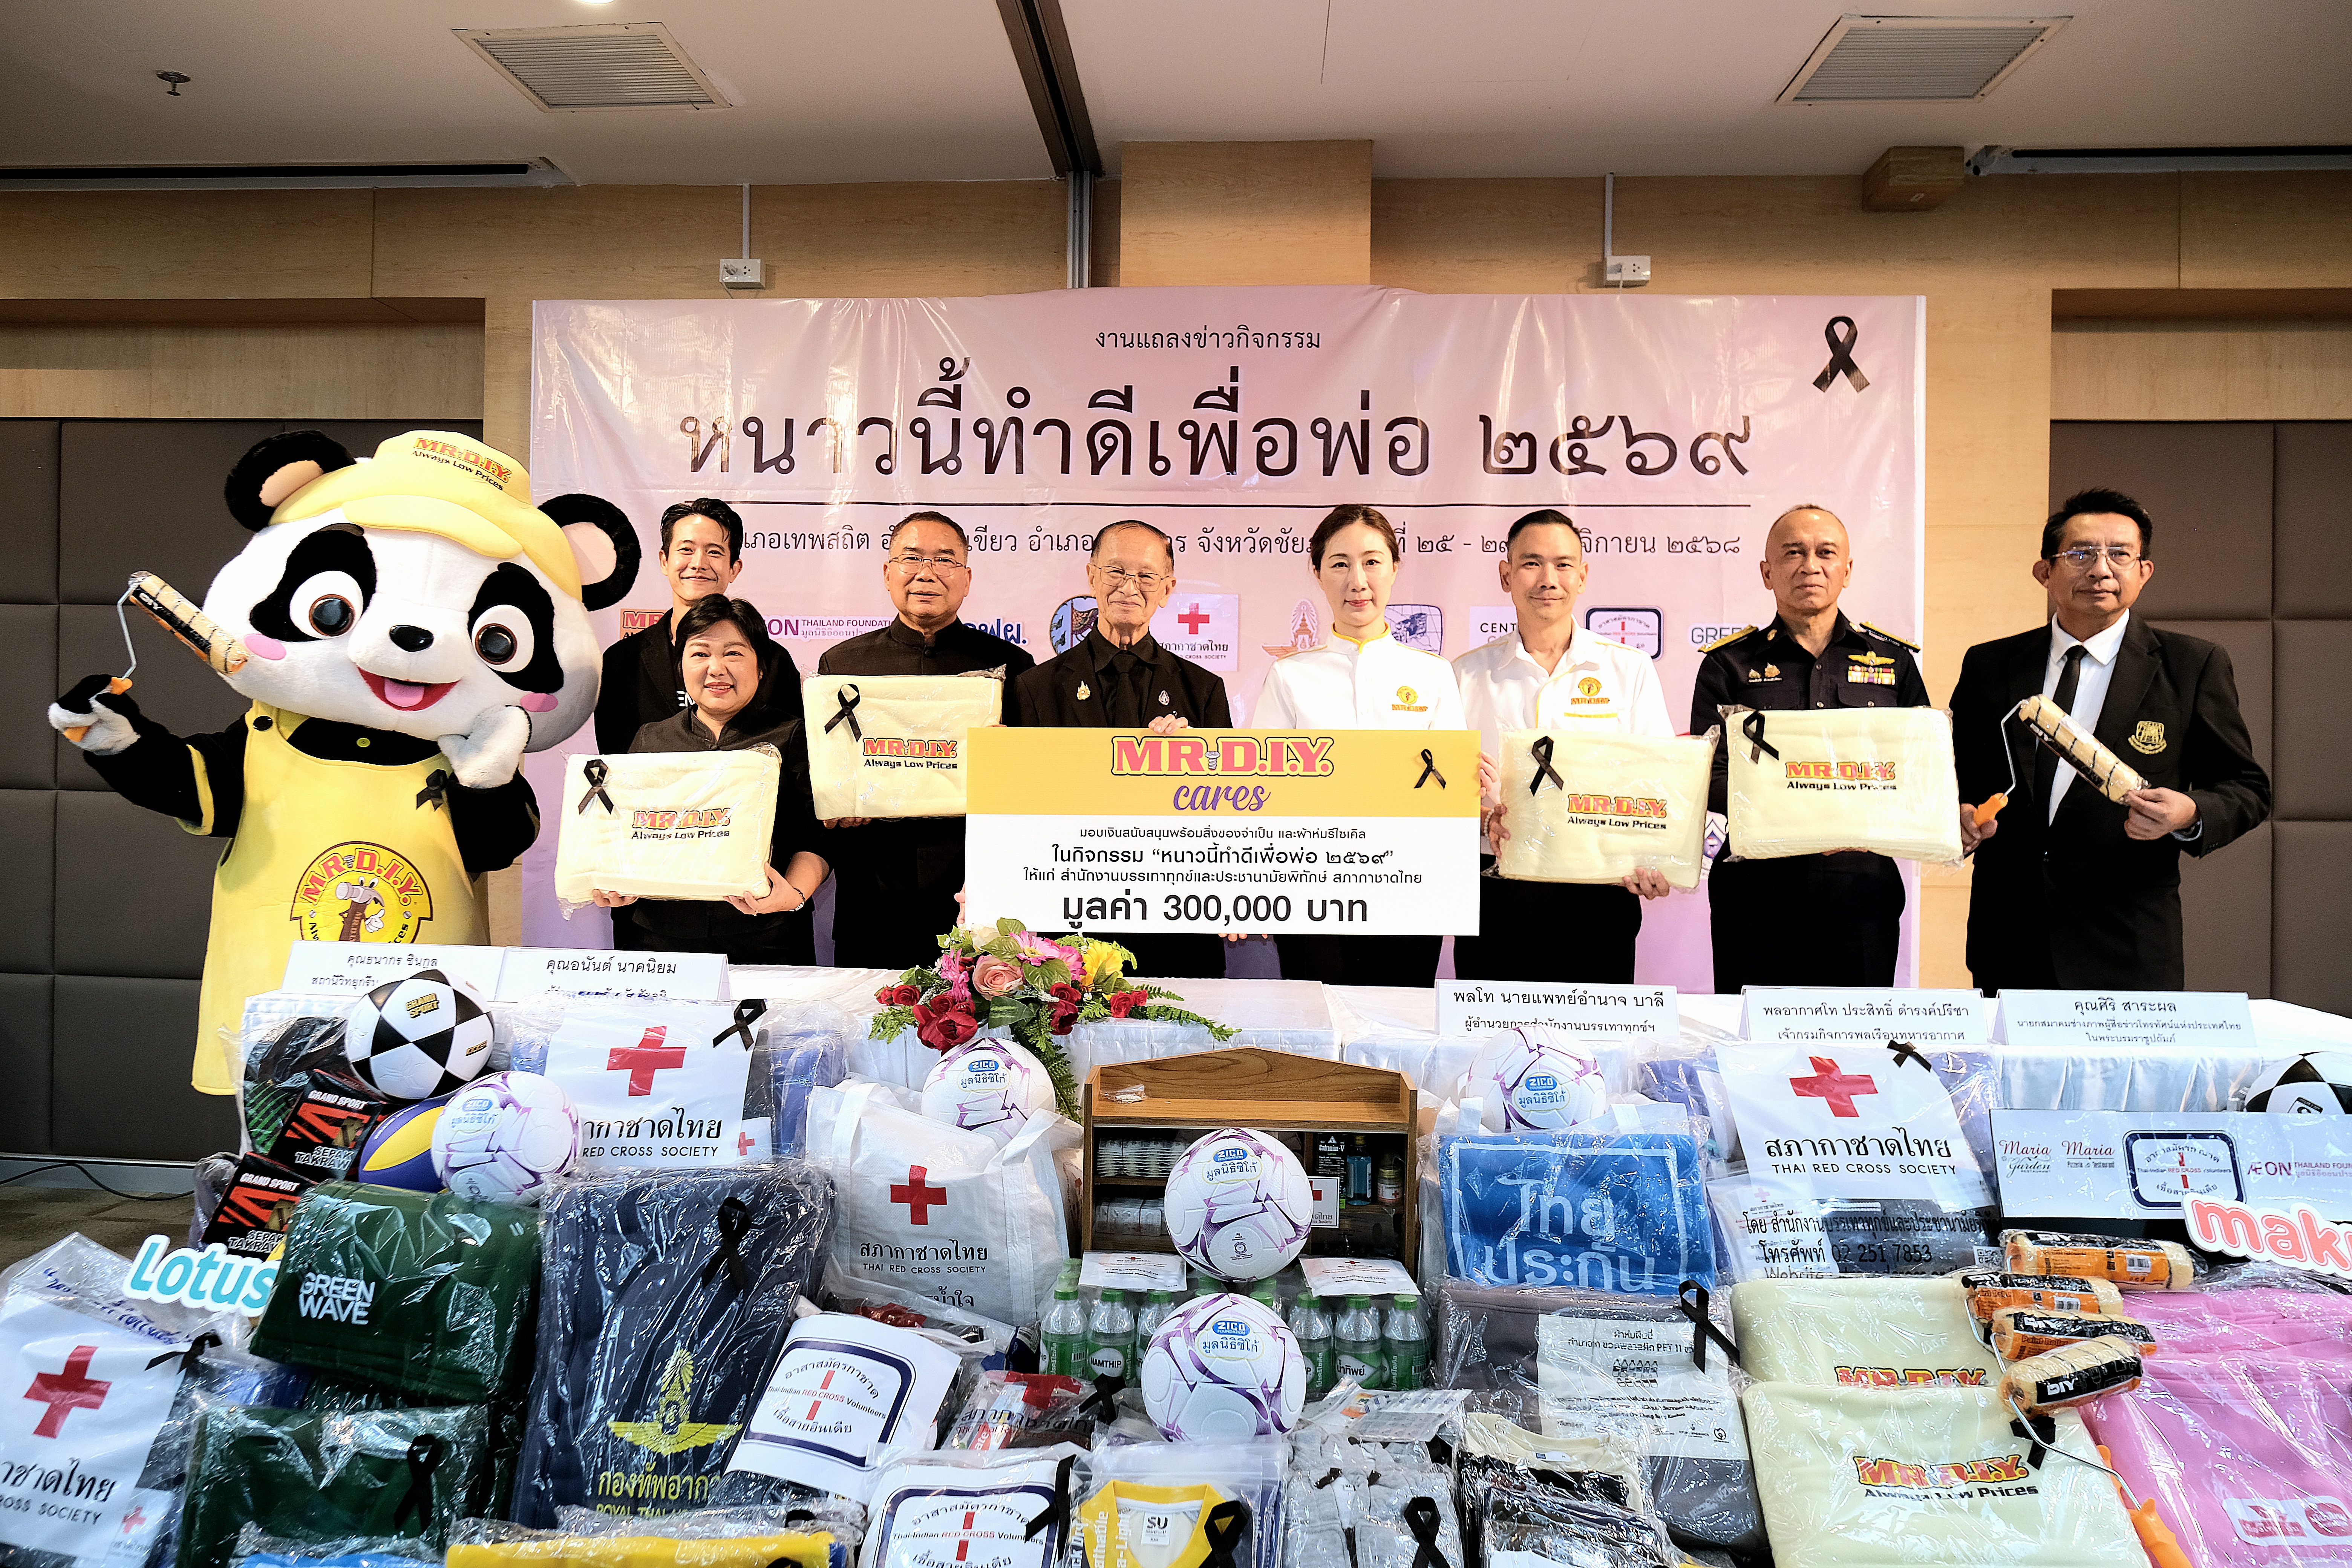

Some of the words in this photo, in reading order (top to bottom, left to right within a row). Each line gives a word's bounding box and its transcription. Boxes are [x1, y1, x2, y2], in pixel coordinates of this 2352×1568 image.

[1096, 326, 1321, 353] งานแถลงข่าวกิจกรรม
[679, 356, 1430, 477] หนาวนี้ทำดีเพื่อพ่อ
[1479, 414, 1750, 476] ๒๕๖๙
[411, 451, 450, 464] Always
[453, 460, 474, 473] Low
[475, 470, 503, 491] Prices
[744, 524, 870, 550] เภอเทพสถิต
[1418, 533, 1455, 553] ๒๕
[1667, 534, 1741, 553] ๒๕๖๘
[864, 759, 901, 769] Always
[1787, 781, 1830, 791] Always
[1173, 785, 1271, 812] cares
[1568, 816, 1606, 827] Always
[1609, 818, 1629, 827] Low
[1632, 820, 1667, 830] Prices
[632, 831, 672, 840] Always
[698, 830, 730, 838] Prices
[1080, 825, 1273, 841] มอบเงินสนับสนุนพร้อมสิ่งของจำเป็น
[1279, 827, 1366, 839] และผ้าห่มรีไซเคิล
[1052, 844, 1143, 863] ในกิจกรรม
[1153, 842, 1317, 864] “หนาวนี้ทำดีเพื่อพ่อ
[1326, 850, 1393, 864] ๒๕๖๙”
[1024, 867, 1055, 881] ให้แก่
[1061, 868, 1327, 885] สำนักงานบรรเทาทุกข์และประชานามัยพิทักษ์
[1333, 870, 1422, 884] สภากาชาดไทย
[1063, 889, 1147, 929] มูลค่า
[1164, 894, 1291, 926] 300,000
[1308, 897, 1367, 922] บาท
[347, 954, 402, 967] คุณธนากร
[547, 956, 614, 975] คุณอนันต์
[618, 959, 677, 974] นาคนิยม
[1454, 987, 1494, 1003] พลโท
[1501, 989, 1627, 1006] นายแพทย์อำนาจ
[1634, 992, 1664, 1008] บาลี
[2122, 1000, 2177, 1012] สาระผล
[1763, 1002, 1838, 1017] พลอากาศโท
[1843, 999, 1893, 1017] ประสิทธิ์
[1898, 1002, 1969, 1017] ดำรงค์ปรีชา
[1778, 1028, 1965, 1040] เจ้ากรมกิจการพลเรือนทหารอากาศ
[961, 1072, 1007, 1088] มูลนิธิซิโก้
[1528, 1077, 1554, 1086] ZICO
[308, 1090, 338, 1104] GRAND
[337, 1096, 368, 1110] SPORT
[1519, 1090, 1566, 1108] มูลนิธิซิโก้
[584, 1107, 722, 1139] ากาชาดไทย
[583, 1147, 605, 1157] RED
[611, 1146, 653, 1156] CROSS
[661, 1146, 718, 1157] SOCIETY
[1765, 1127, 1951, 1158] สภากาชาดไทย
[1999, 1139, 2052, 1155] Maria
[2062, 1140, 2115, 1156] Maria
[294, 1152, 352, 1170] TAKRAW
[312, 1146, 356, 1159] SEPAK
[1206, 1162, 1257, 1181] มูลนิธิซิโก้
[1772, 1164, 1806, 1174] THAI
[1813, 1163, 1839, 1173] RED
[1847, 1164, 1891, 1173] CROSS
[1899, 1165, 1956, 1175] SOCIETY
[240, 1173, 271, 1187] GRAND
[269, 1177, 300, 1191] SPORT
[1742, 1211, 1767, 1234] โดย
[2192, 1199, 2352, 1271] mak
[860, 1239, 988, 1261] สภากาชาดไทย
[1759, 1239, 1826, 1263] โทรศัพท์
[1832, 1245, 1850, 1263] 02
[1858, 1245, 1886, 1263] 251
[1896, 1244, 1932, 1263] 7853
[131, 1241, 278, 1309] Lotus
[863, 1263, 884, 1272] THAI
[890, 1264, 906, 1273] RED
[911, 1266, 941, 1274] CROSS
[947, 1265, 986, 1273] SOCIETY
[301, 1272, 376, 1303] GREEN
[299, 1294, 371, 1325] WAVE
[1217, 1321, 1246, 1331] ZICO
[1202, 1337, 1259, 1353] มูลนิธิซิโก้
[784, 1357, 880, 1400] อาสาสมัครกาชาด
[2047, 1378, 2075, 1395] DIY
[802, 1389, 817, 1398] RED
[818, 1391, 845, 1403] CROSS
[846, 1398, 886, 1419] Volunteers
[0, 1456, 117, 1503] าชาดไทย
[1978, 1485, 2039, 1498] Prices
[38, 1502, 103, 1525] SOCIETY
[1146, 1515, 1168, 1530] SU
